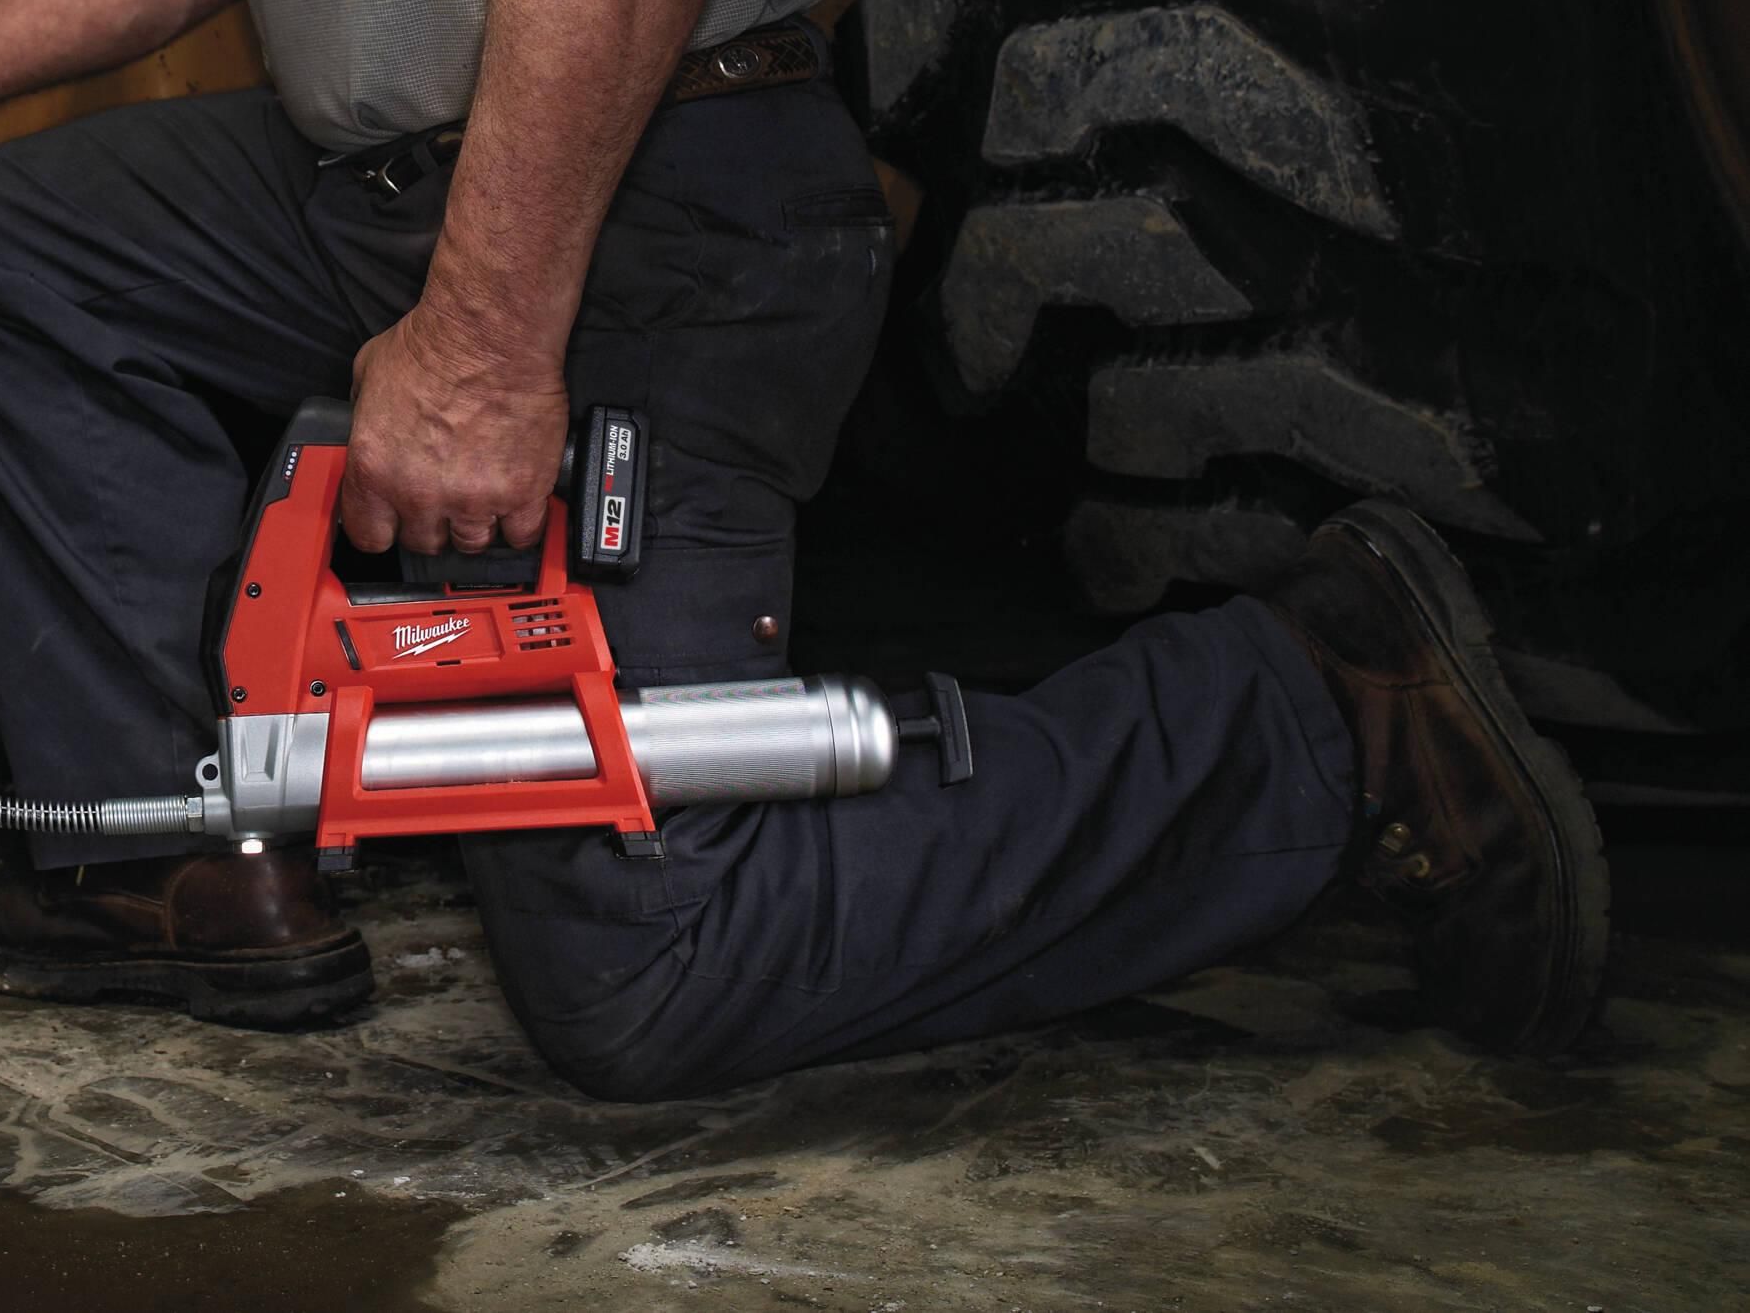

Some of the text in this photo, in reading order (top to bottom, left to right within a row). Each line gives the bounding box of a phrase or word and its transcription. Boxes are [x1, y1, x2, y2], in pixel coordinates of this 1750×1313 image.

[620, 430, 629, 459] 3.0 Ah
[604, 499, 623, 547] M12
[391, 616, 472, 651] Milwaukee
